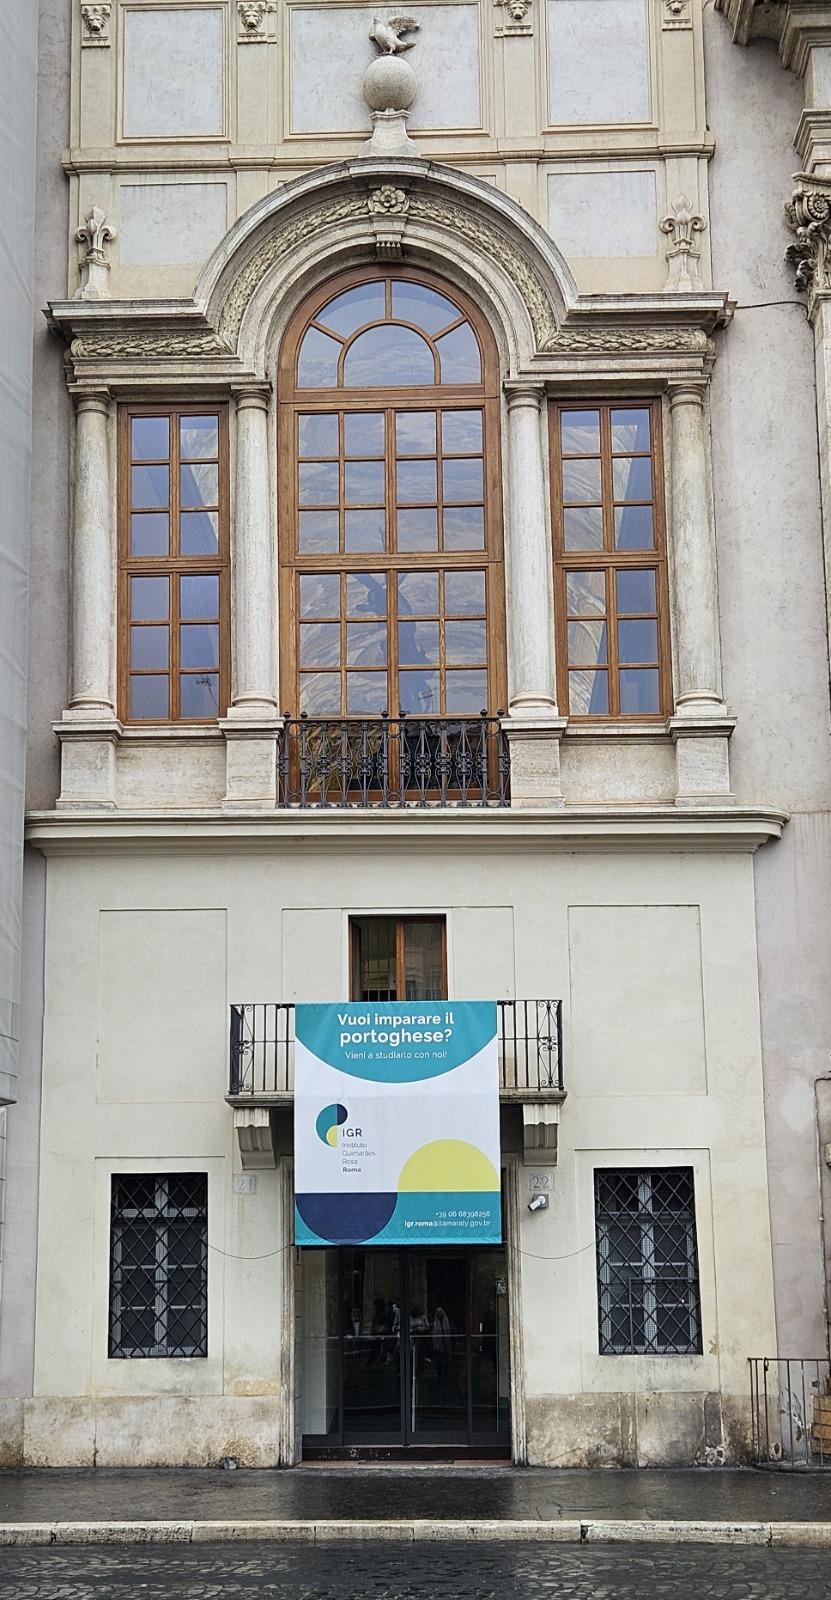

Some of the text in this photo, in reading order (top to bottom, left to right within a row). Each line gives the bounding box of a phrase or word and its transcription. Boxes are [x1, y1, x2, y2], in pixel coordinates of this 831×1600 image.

[337, 1011, 455, 1028] Vuoi imparare il
[340, 1028, 452, 1047] portoghese?
[345, 1050, 366, 1059] Vieni
[375, 1050, 412, 1059] studiarlo
[414, 1051, 430, 1059] con
[432, 1050, 447, 1058] noi!
[342, 1128, 363, 1138] IGR
[532, 1175, 549, 1189] 22
